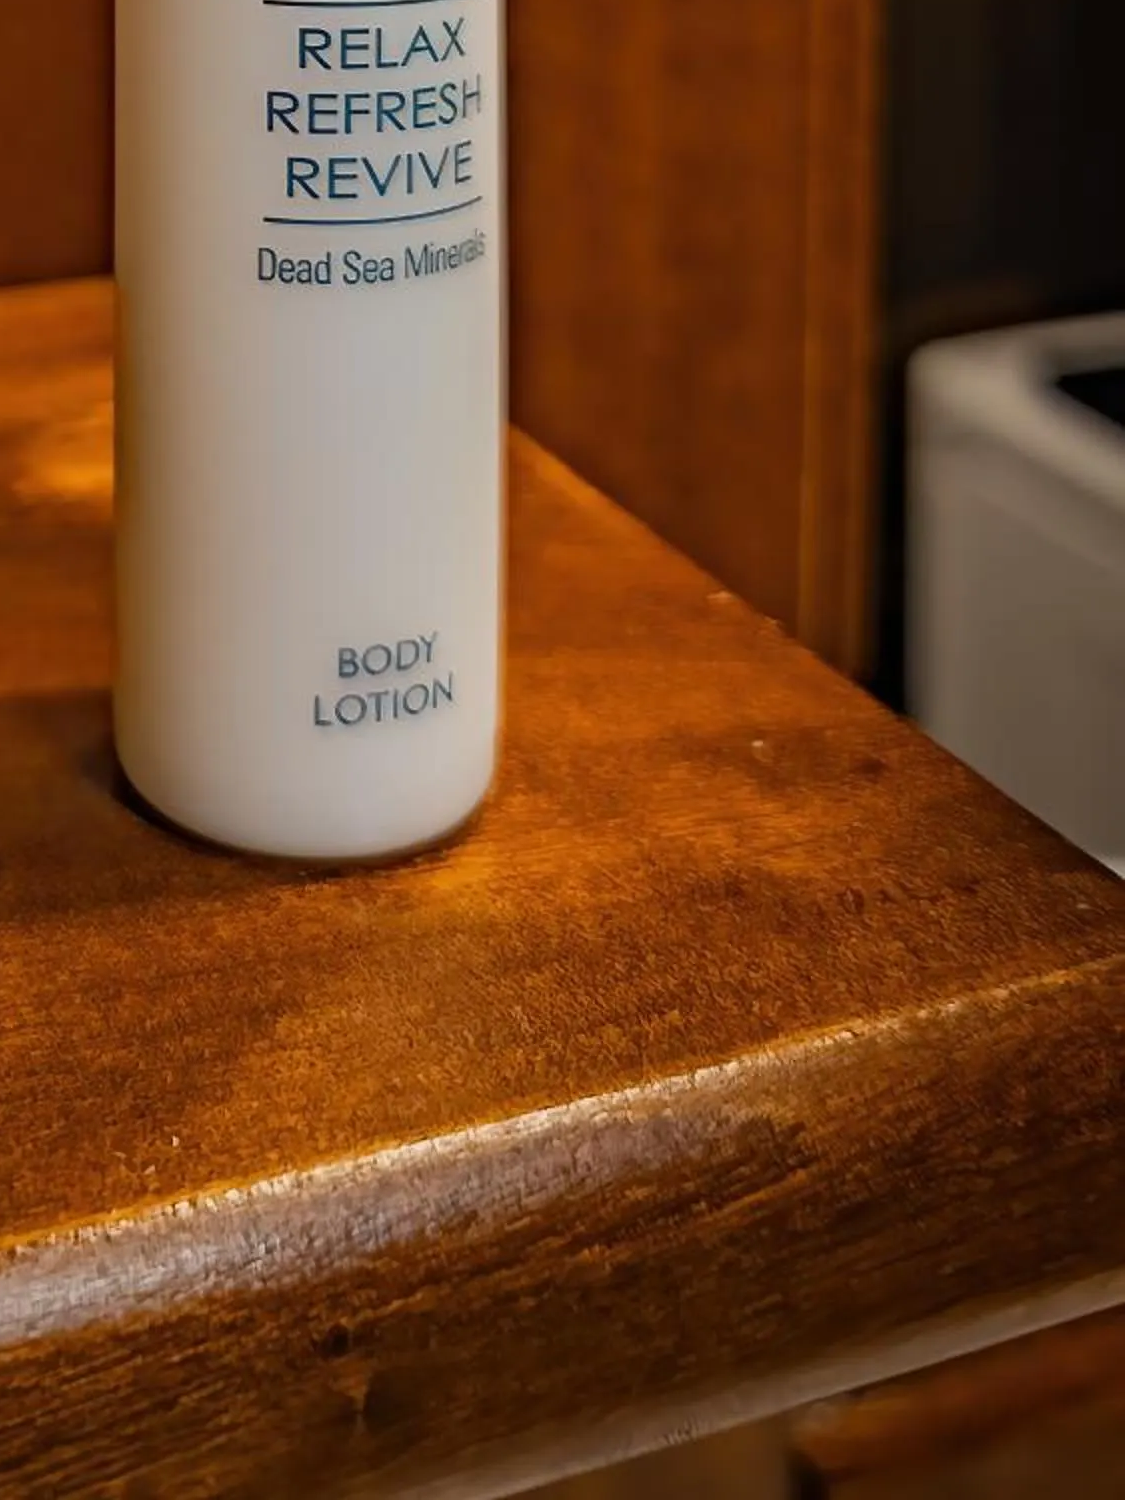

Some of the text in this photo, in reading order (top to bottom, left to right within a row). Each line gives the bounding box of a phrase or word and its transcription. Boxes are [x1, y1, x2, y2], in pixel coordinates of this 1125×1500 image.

[297, 16, 466, 70] RELAX
[265, 73, 482, 135] REFRESH
[285, 139, 473, 199] REVIVE
[257, 247, 332, 285] Dead
[341, 250, 395, 285] Sea
[338, 630, 439, 678] BODY
[313, 671, 454, 727] LOTION
